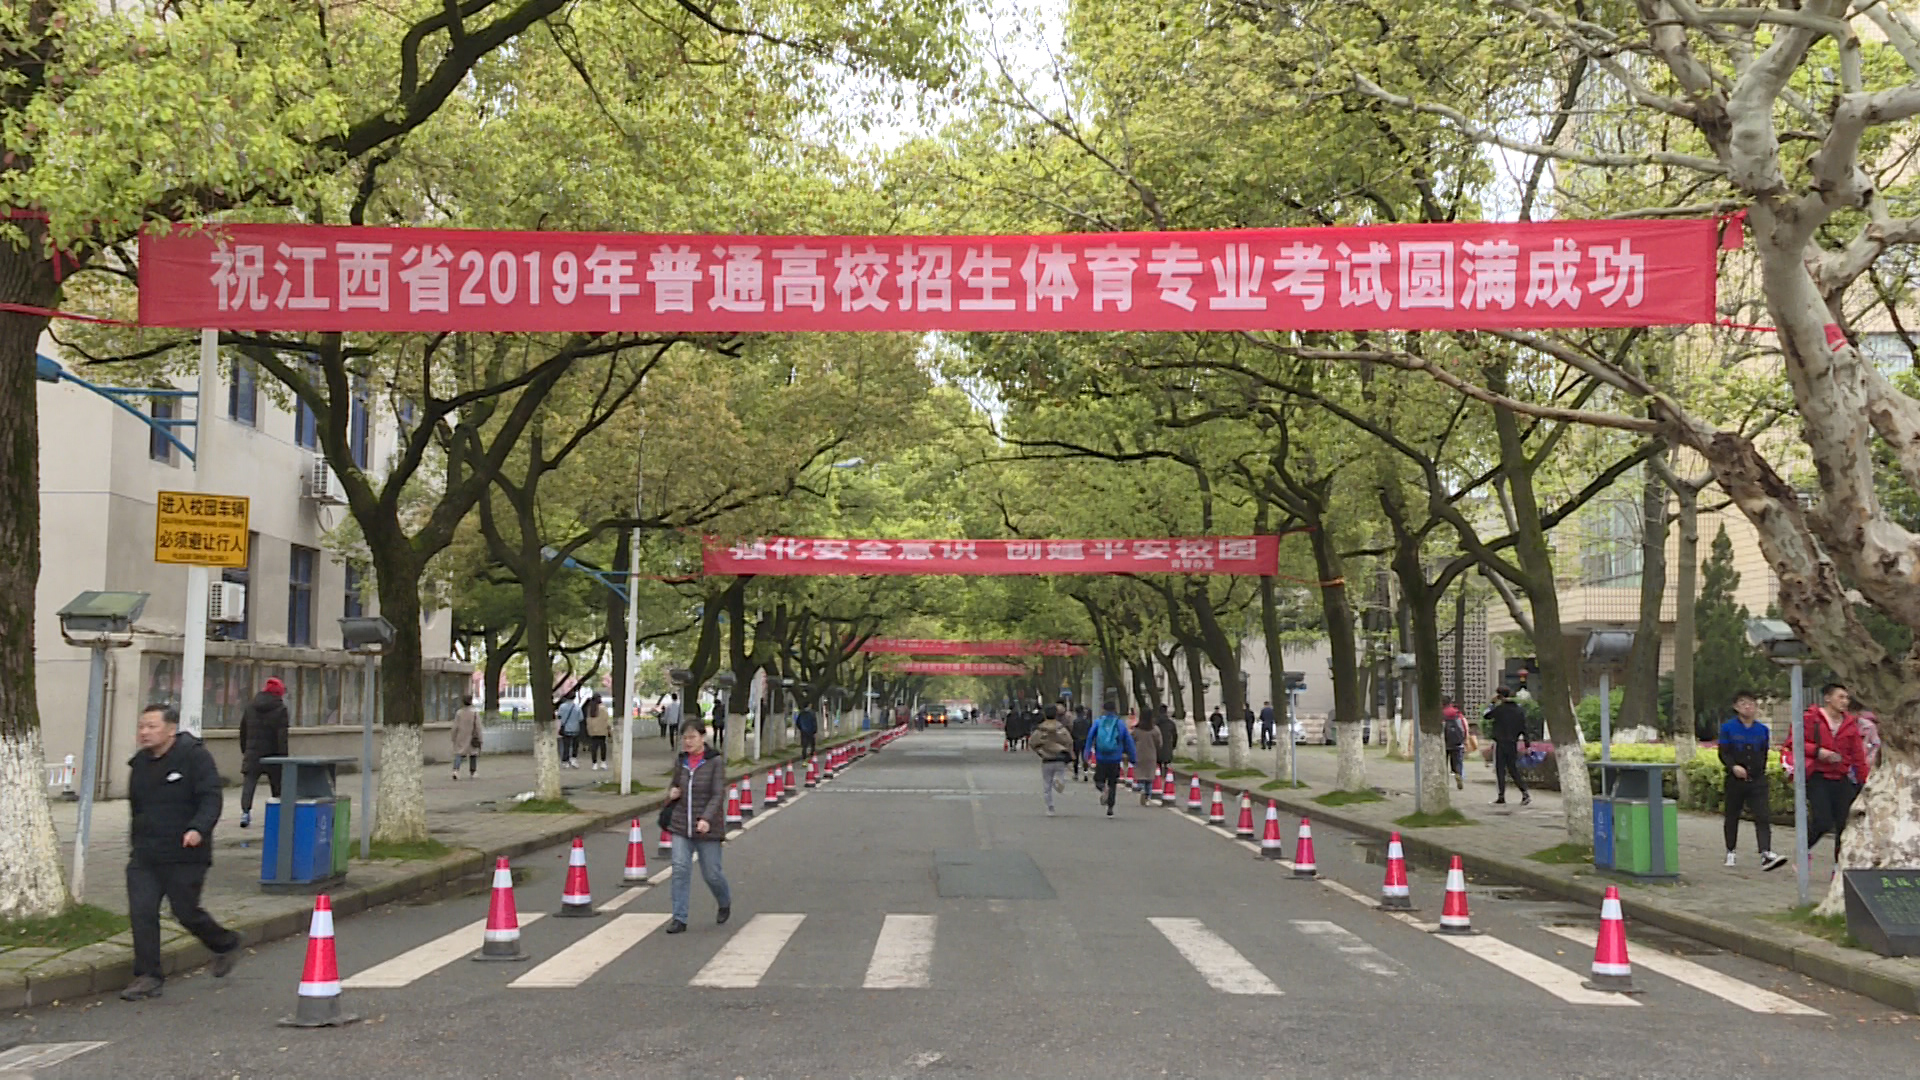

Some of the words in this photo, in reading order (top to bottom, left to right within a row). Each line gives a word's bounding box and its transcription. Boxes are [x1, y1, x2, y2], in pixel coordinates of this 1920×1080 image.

[209, 239, 1646, 313] 祝江西省2019年普通高校招生体育专业考试圆满成功
[161, 496, 245, 519] 进入校园车辆
[159, 530, 243, 552] 必须避让行人
[728, 537, 979, 561] 强化安全意识
[1004, 538, 1257, 561] 创建平安校园
